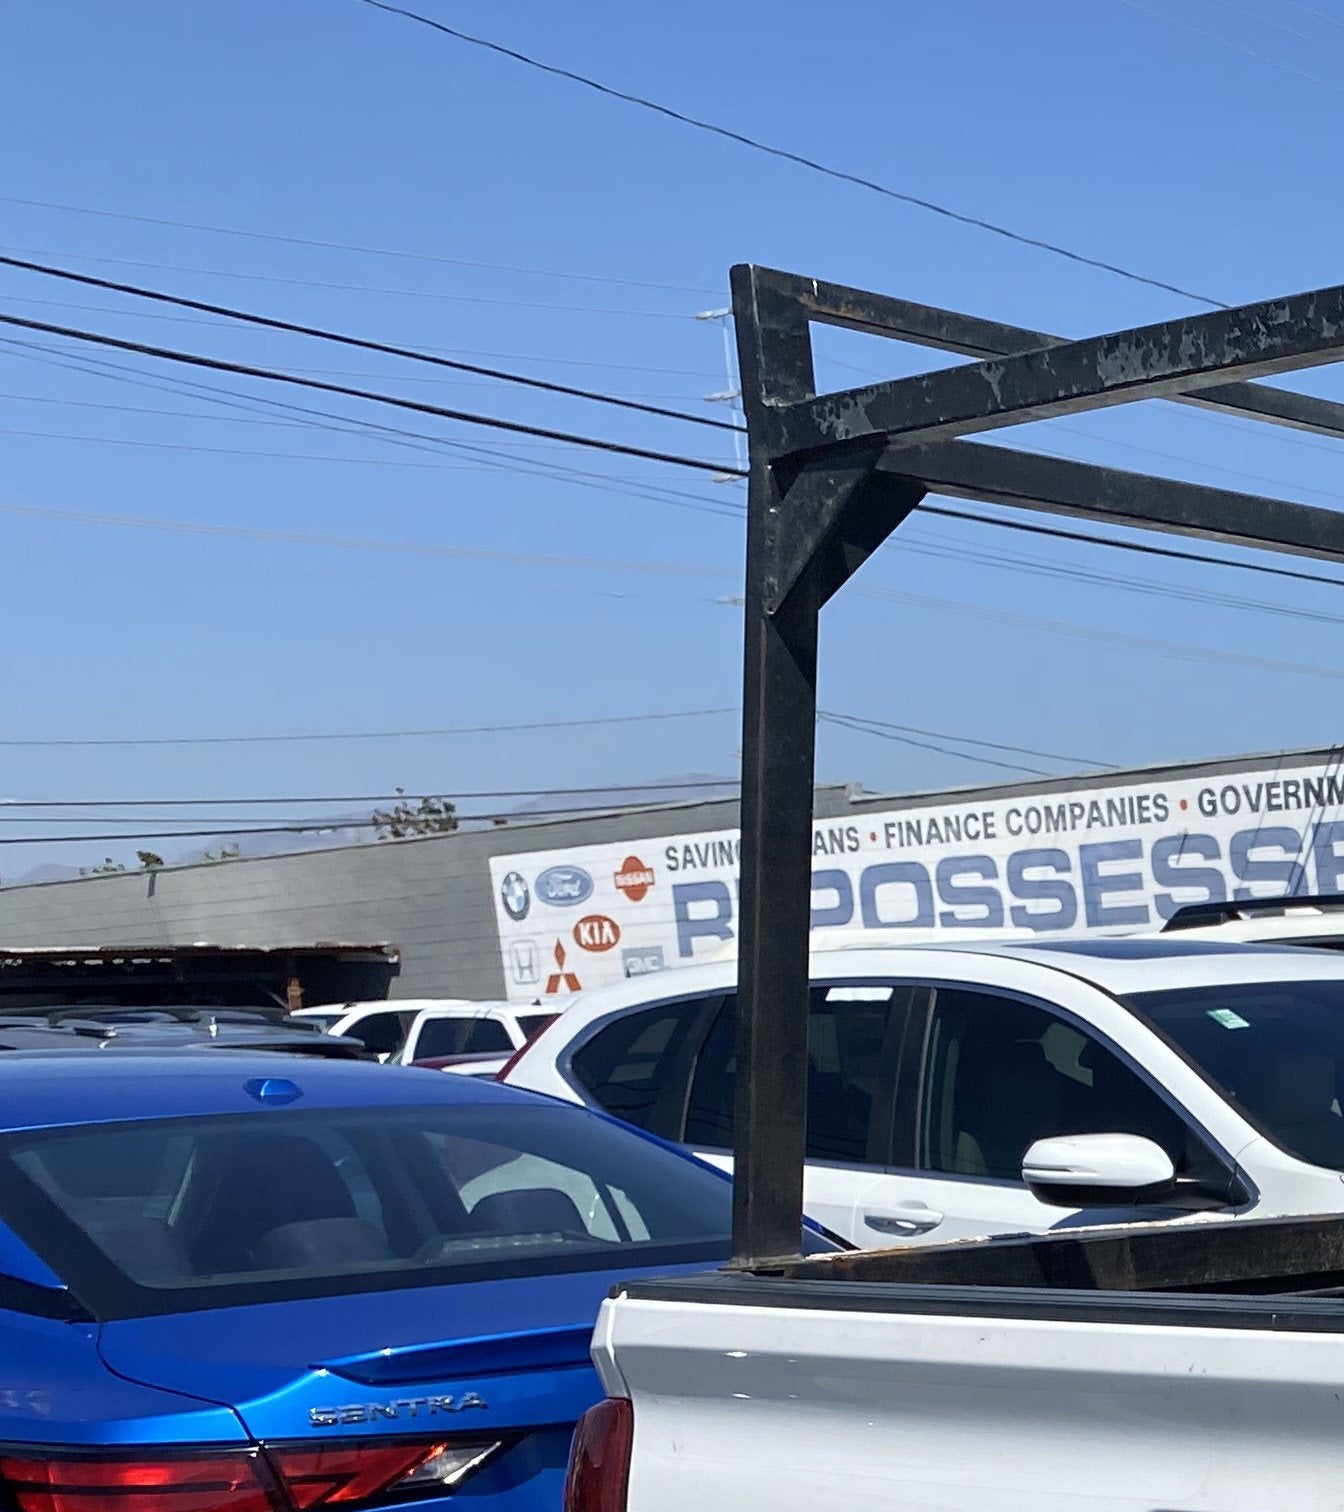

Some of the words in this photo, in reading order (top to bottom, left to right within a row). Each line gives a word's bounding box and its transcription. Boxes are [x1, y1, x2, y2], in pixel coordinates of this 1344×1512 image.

[665, 840, 741, 872] SAVIN
[884, 811, 997, 849] FINANCE
[1005, 794, 1169, 836] COMPANIES
[580, 920, 616, 945] KIA
[310, 1392, 489, 1427] SENTRA
